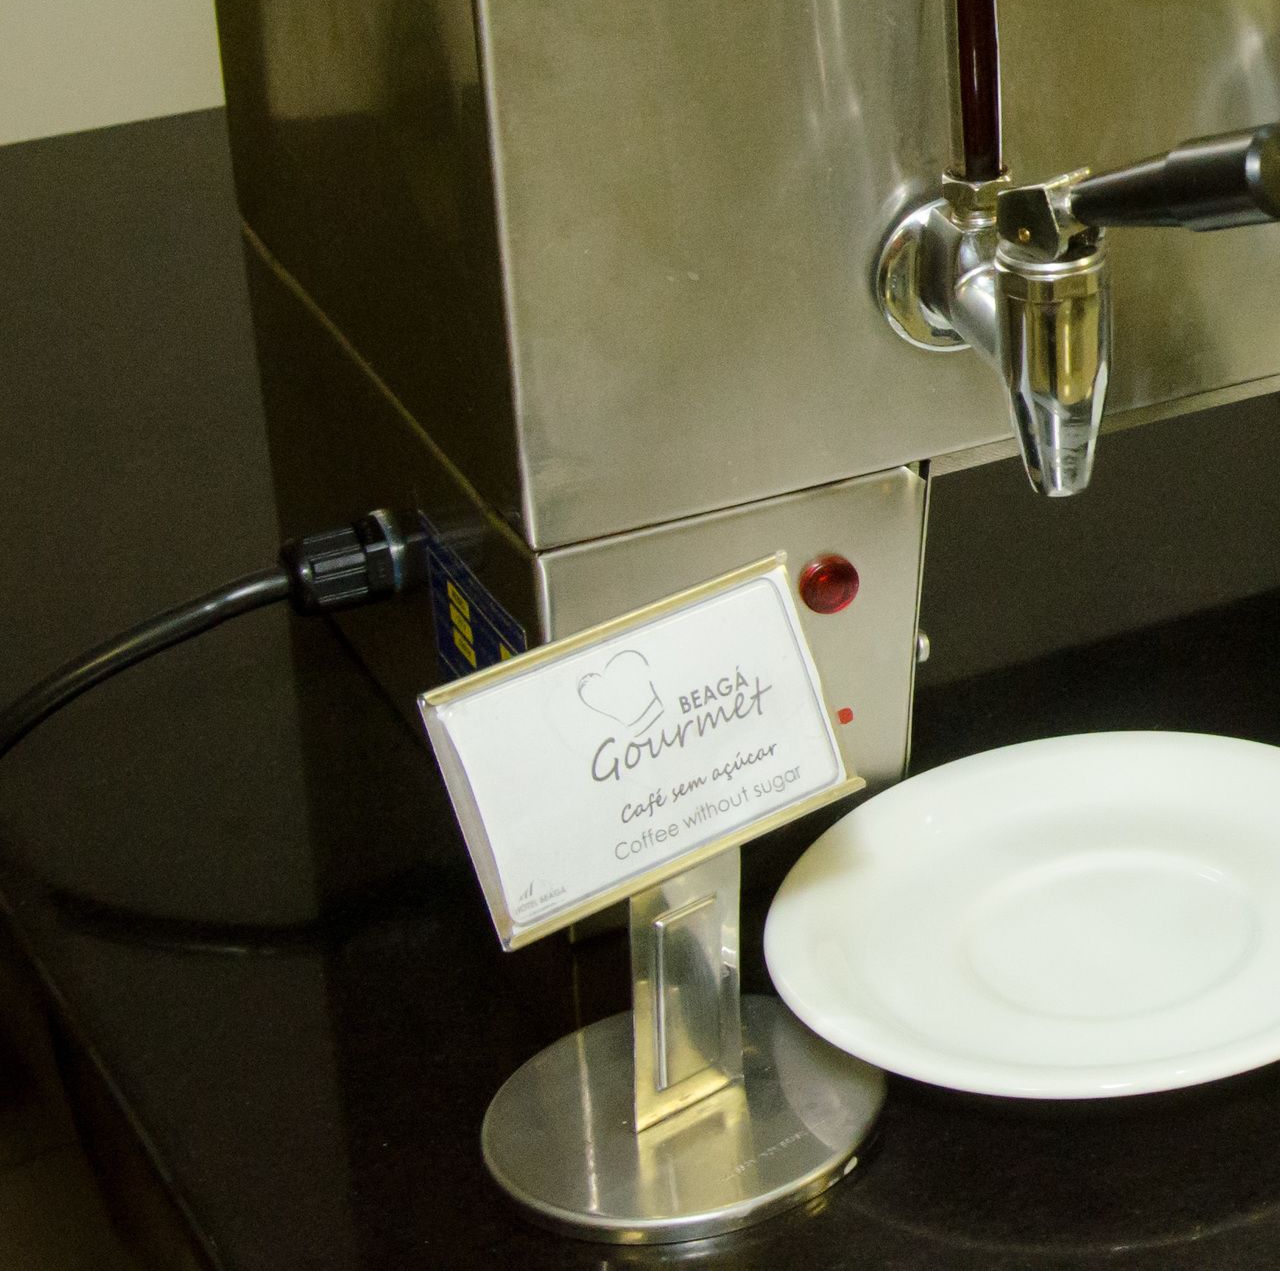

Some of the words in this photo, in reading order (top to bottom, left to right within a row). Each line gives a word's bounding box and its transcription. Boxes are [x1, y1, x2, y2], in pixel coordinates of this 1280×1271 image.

[591, 676, 773, 782] Gourmet
[679, 666, 749, 714] BEAGÁ
[614, 822, 680, 861] Coffee
[683, 786, 750, 826] without
[752, 765, 801, 799] sugar
[620, 787, 667, 824] Café
[672, 776, 708, 803] sem
[711, 743, 777, 780] açúcar
